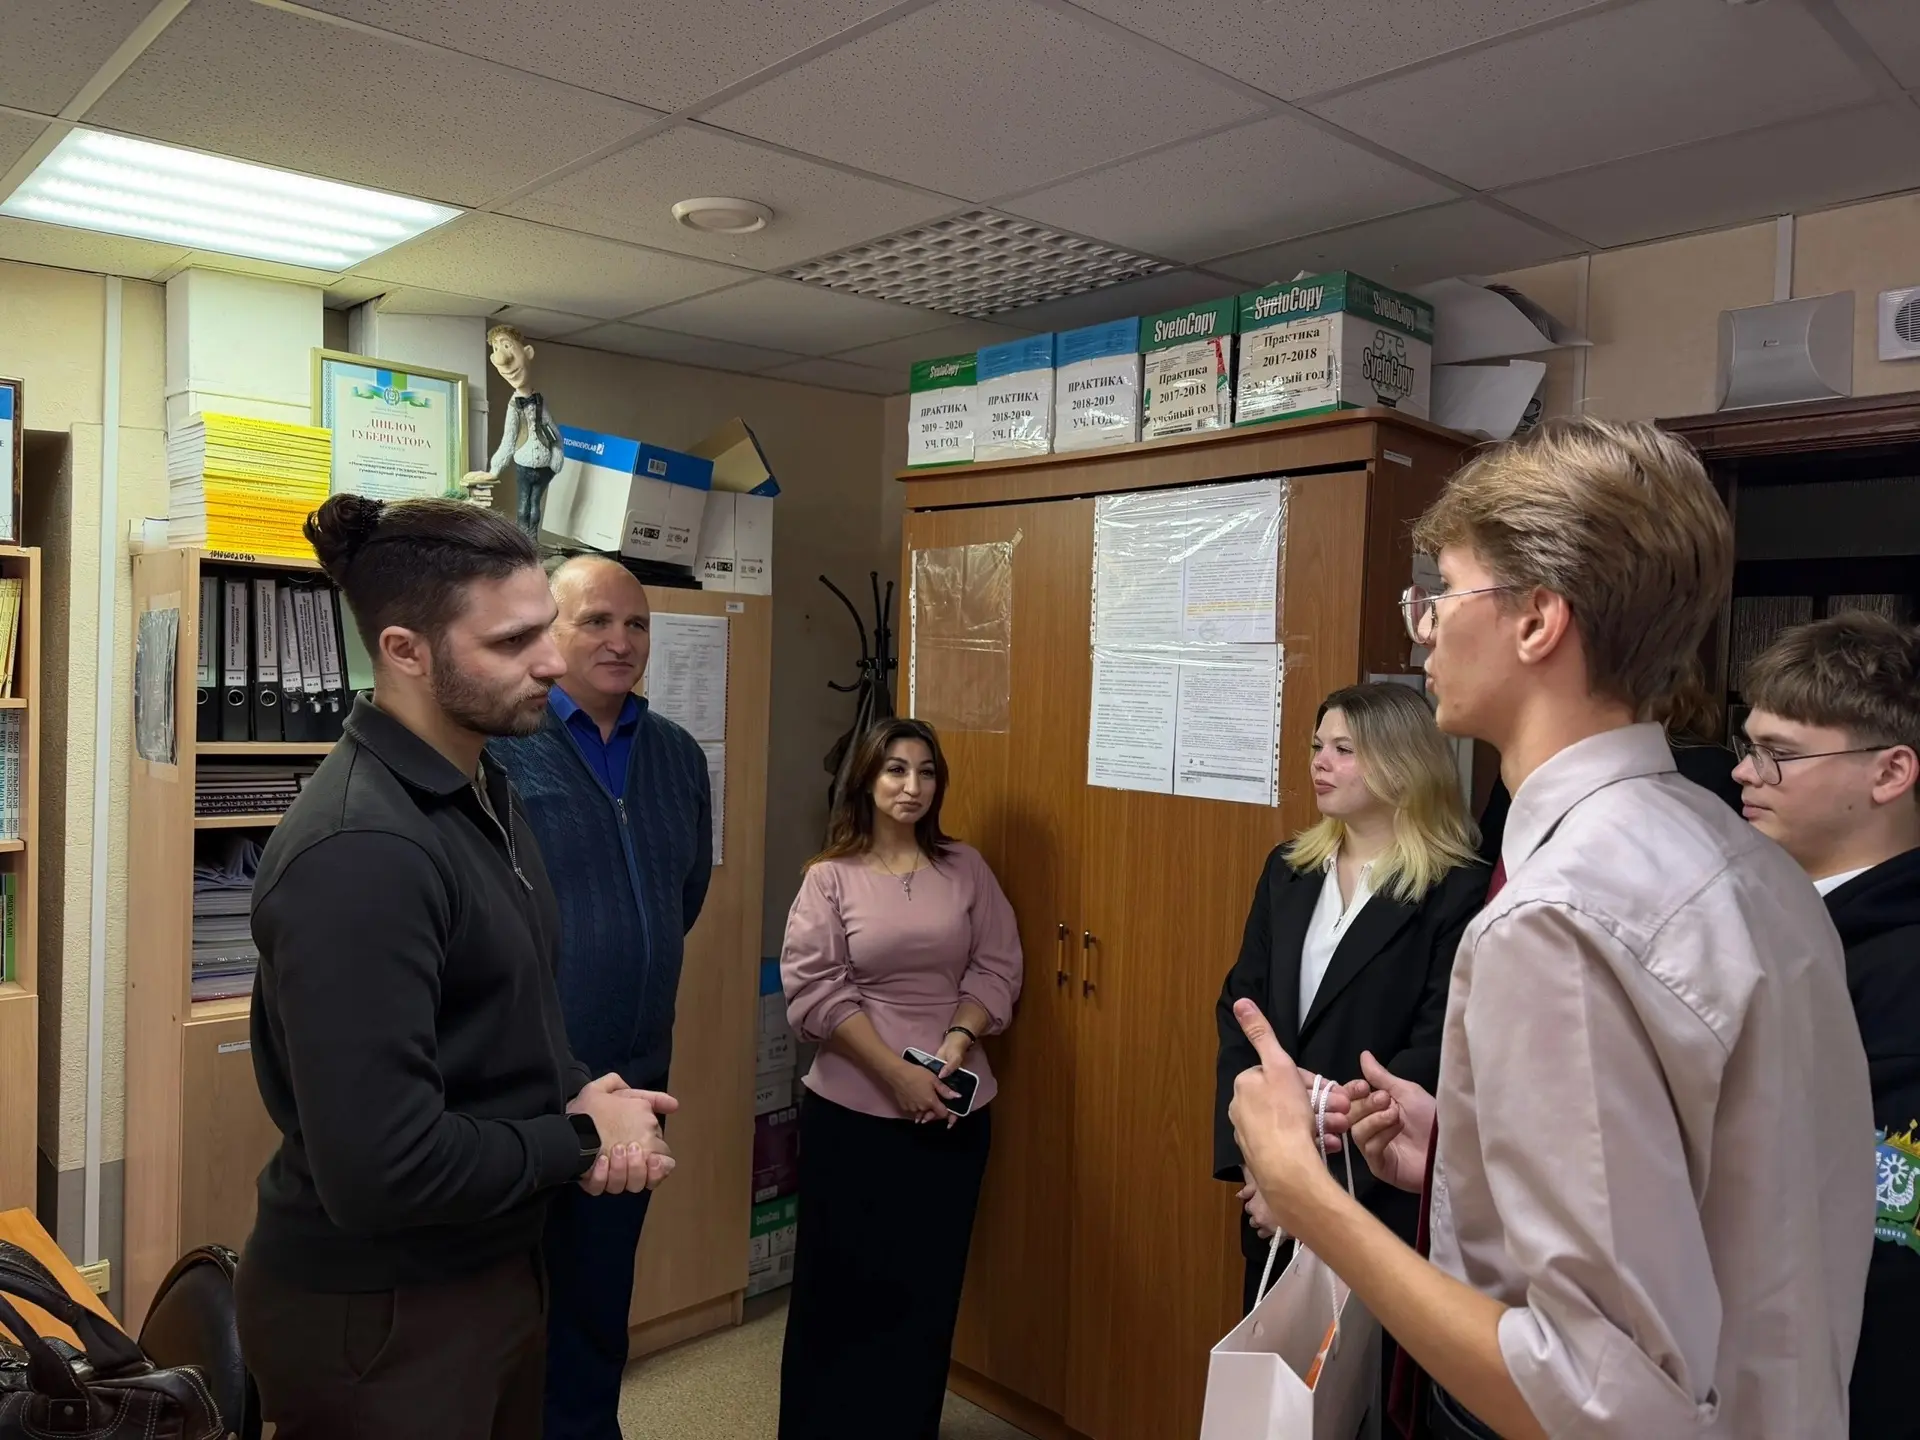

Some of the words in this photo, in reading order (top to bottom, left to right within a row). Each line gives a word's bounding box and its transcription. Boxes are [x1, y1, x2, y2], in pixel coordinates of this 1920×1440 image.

[1254, 285, 1324, 320] SvetoCopy
[1373, 291, 1416, 331] SvetoCopy
[1154, 311, 1217, 343] SvetoCopy
[1264, 328, 1320, 348] Практика
[1262, 347, 1318, 368] 2017-2018
[1159, 366, 1208, 385] Практика
[1305, 369, 1325, 381] год
[1363, 346, 1415, 397] SvetoCopy
[1068, 375, 1124, 393] ПРАКТИКА
[988, 392, 1039, 406] ПРАКТИКА
[1071, 394, 1115, 410] 2018-2019
[1159, 384, 1206, 404] 2017-2018
[920, 403, 968, 417] ПРАКТИКА
[1197, 403, 1215, 415] год
[367, 418, 417, 434] ДИПЛОМ
[921, 422, 938, 433] 2019
[945, 420, 963, 431] 2020
[1073, 417, 1089, 429] УЧ.
[1091, 413, 1112, 426] ГОД
[351, 429, 432, 449] ГУБЕРНАТОРА
[992, 429, 1006, 440] УЧ.
[925, 440, 939, 450] УЧ.
[940, 437, 960, 448] ГОД
[632, 526, 644, 537] A4
[704, 561, 716, 570] A4
